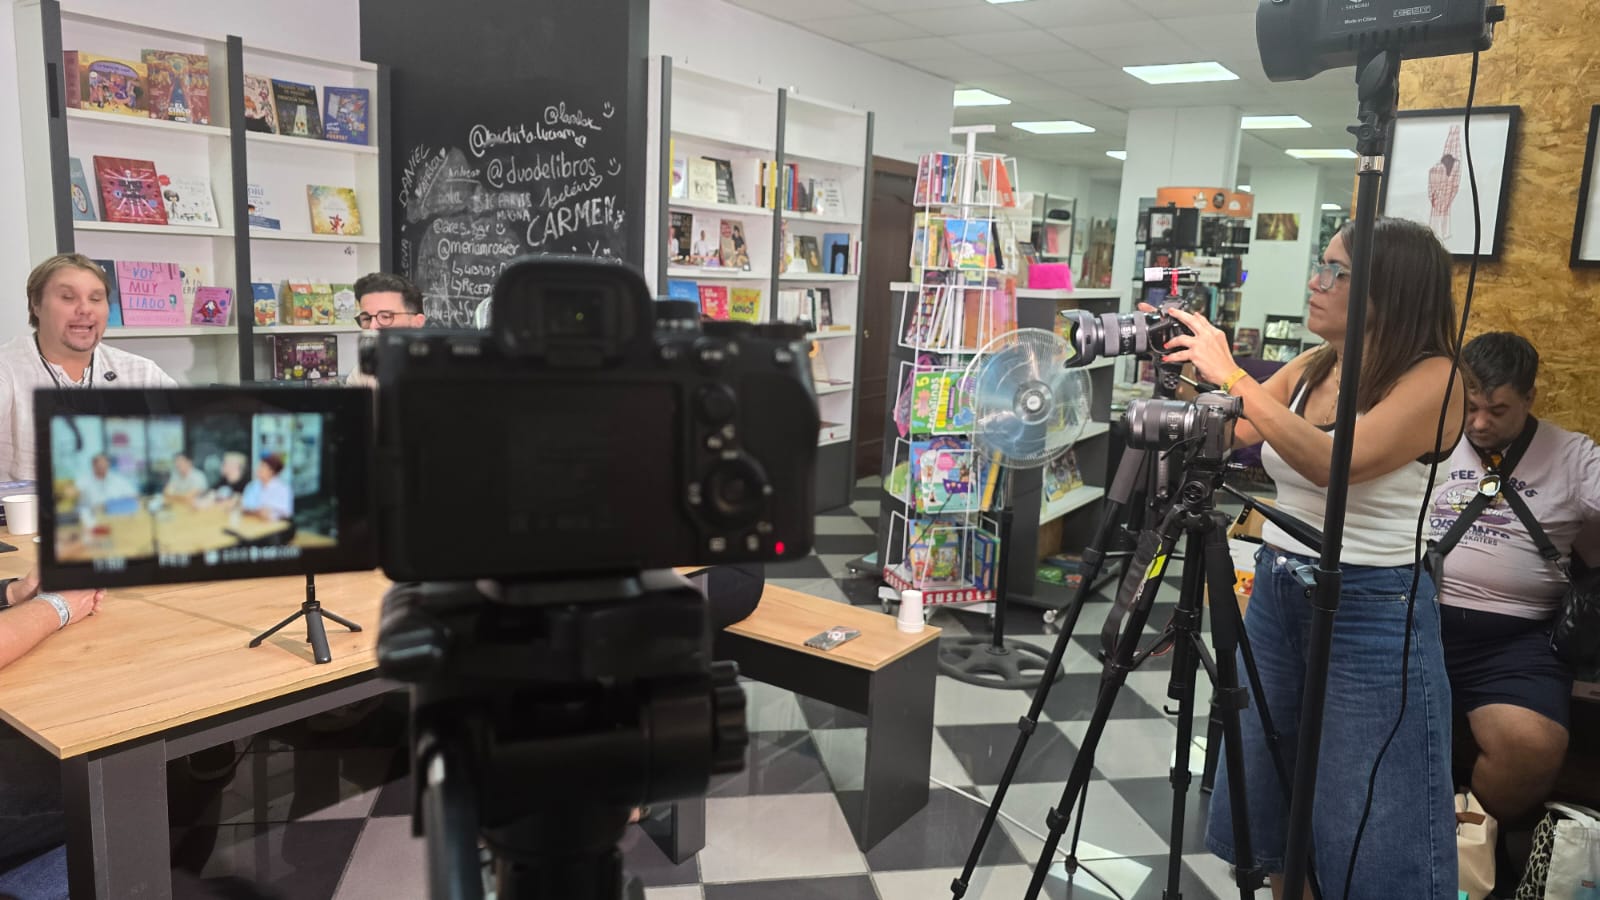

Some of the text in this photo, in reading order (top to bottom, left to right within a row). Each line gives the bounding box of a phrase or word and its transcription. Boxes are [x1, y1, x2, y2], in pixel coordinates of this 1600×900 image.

[487, 151, 596, 188] @duodelibros
[526, 196, 616, 247] CARMEN
[129, 281, 159, 294] MUY
[128, 295, 165, 310] LIADO
